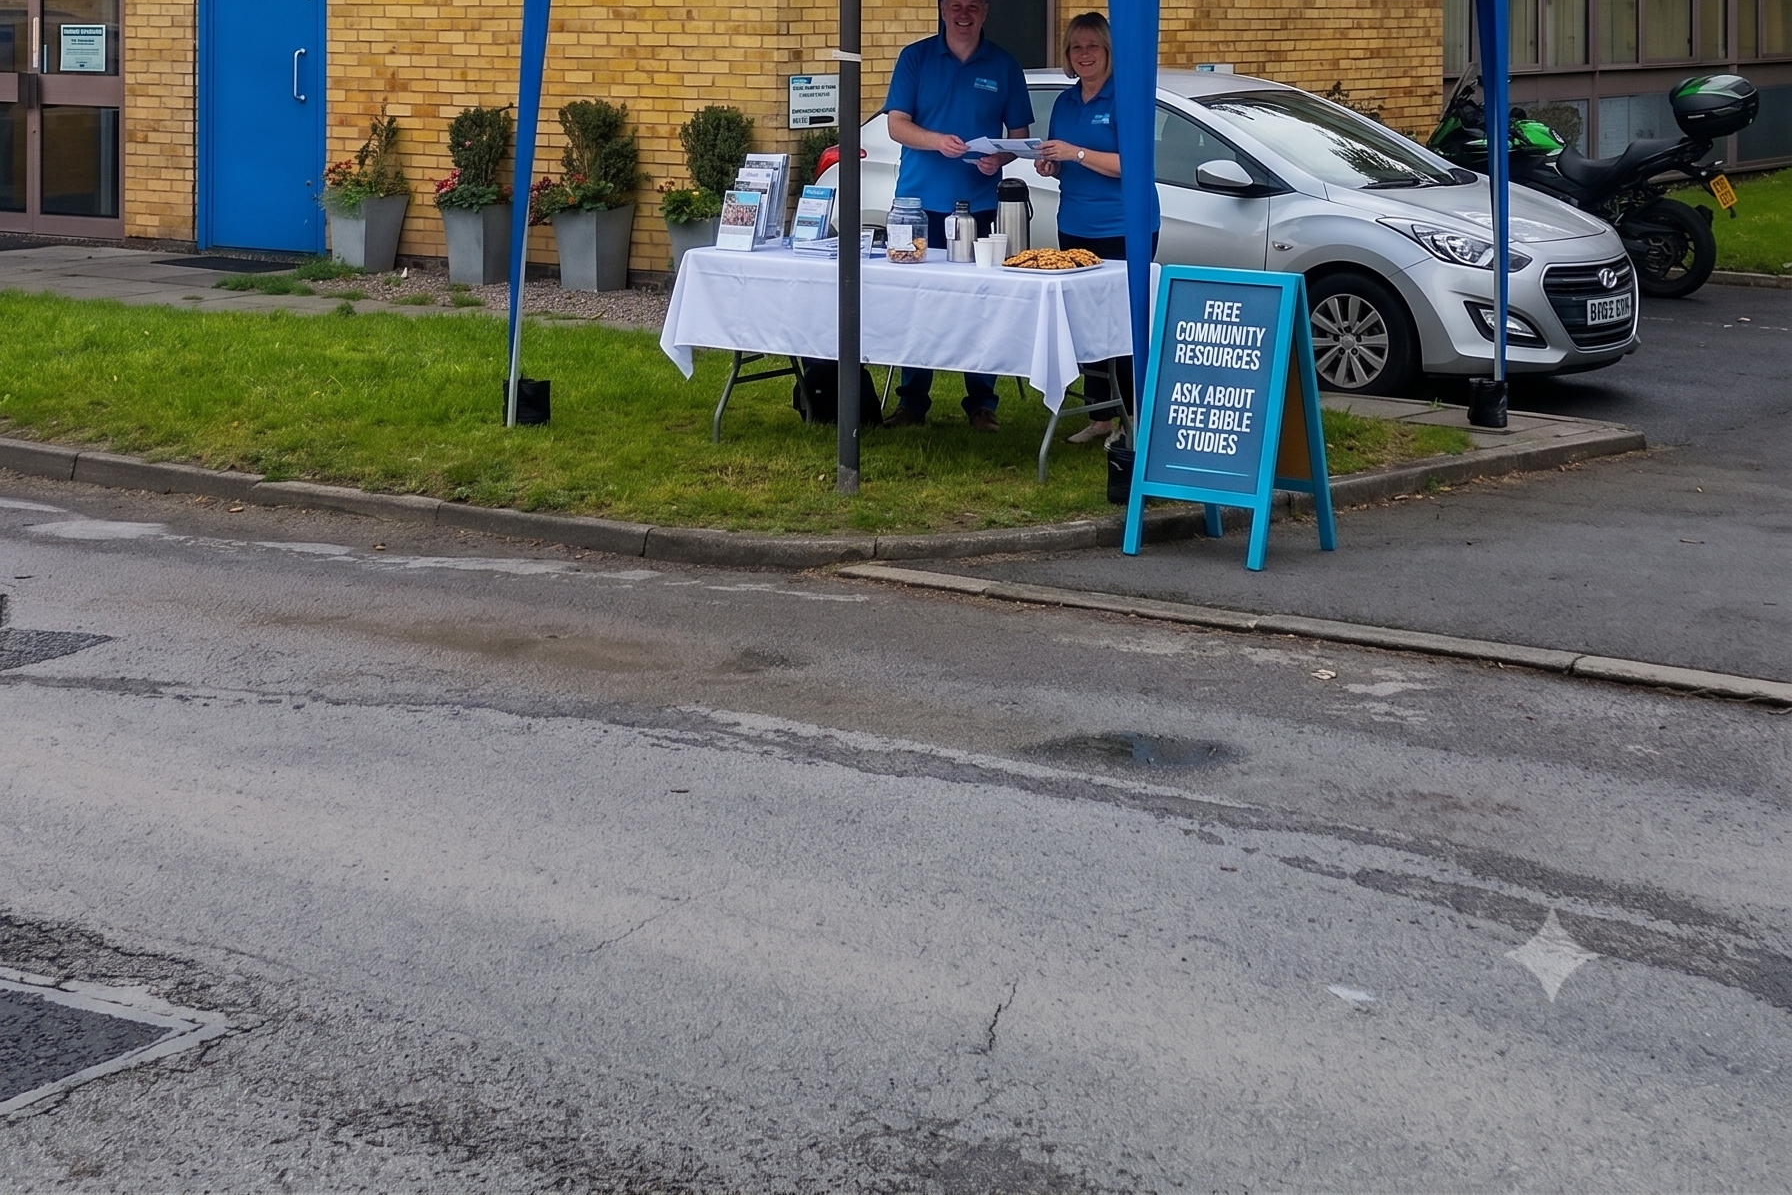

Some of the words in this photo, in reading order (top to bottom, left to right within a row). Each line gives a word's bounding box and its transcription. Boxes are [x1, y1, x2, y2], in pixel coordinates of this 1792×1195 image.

[1203, 300, 1243, 323] FREE
[1175, 321, 1267, 348] COMMUNITY
[1174, 344, 1262, 371] RESOURCES
[1170, 382, 1203, 404] ASK
[1203, 386, 1256, 409] ABOUT
[1168, 405, 1205, 428] FREE
[1208, 409, 1253, 433] BIBLE
[1176, 429, 1239, 456] STUDIES
